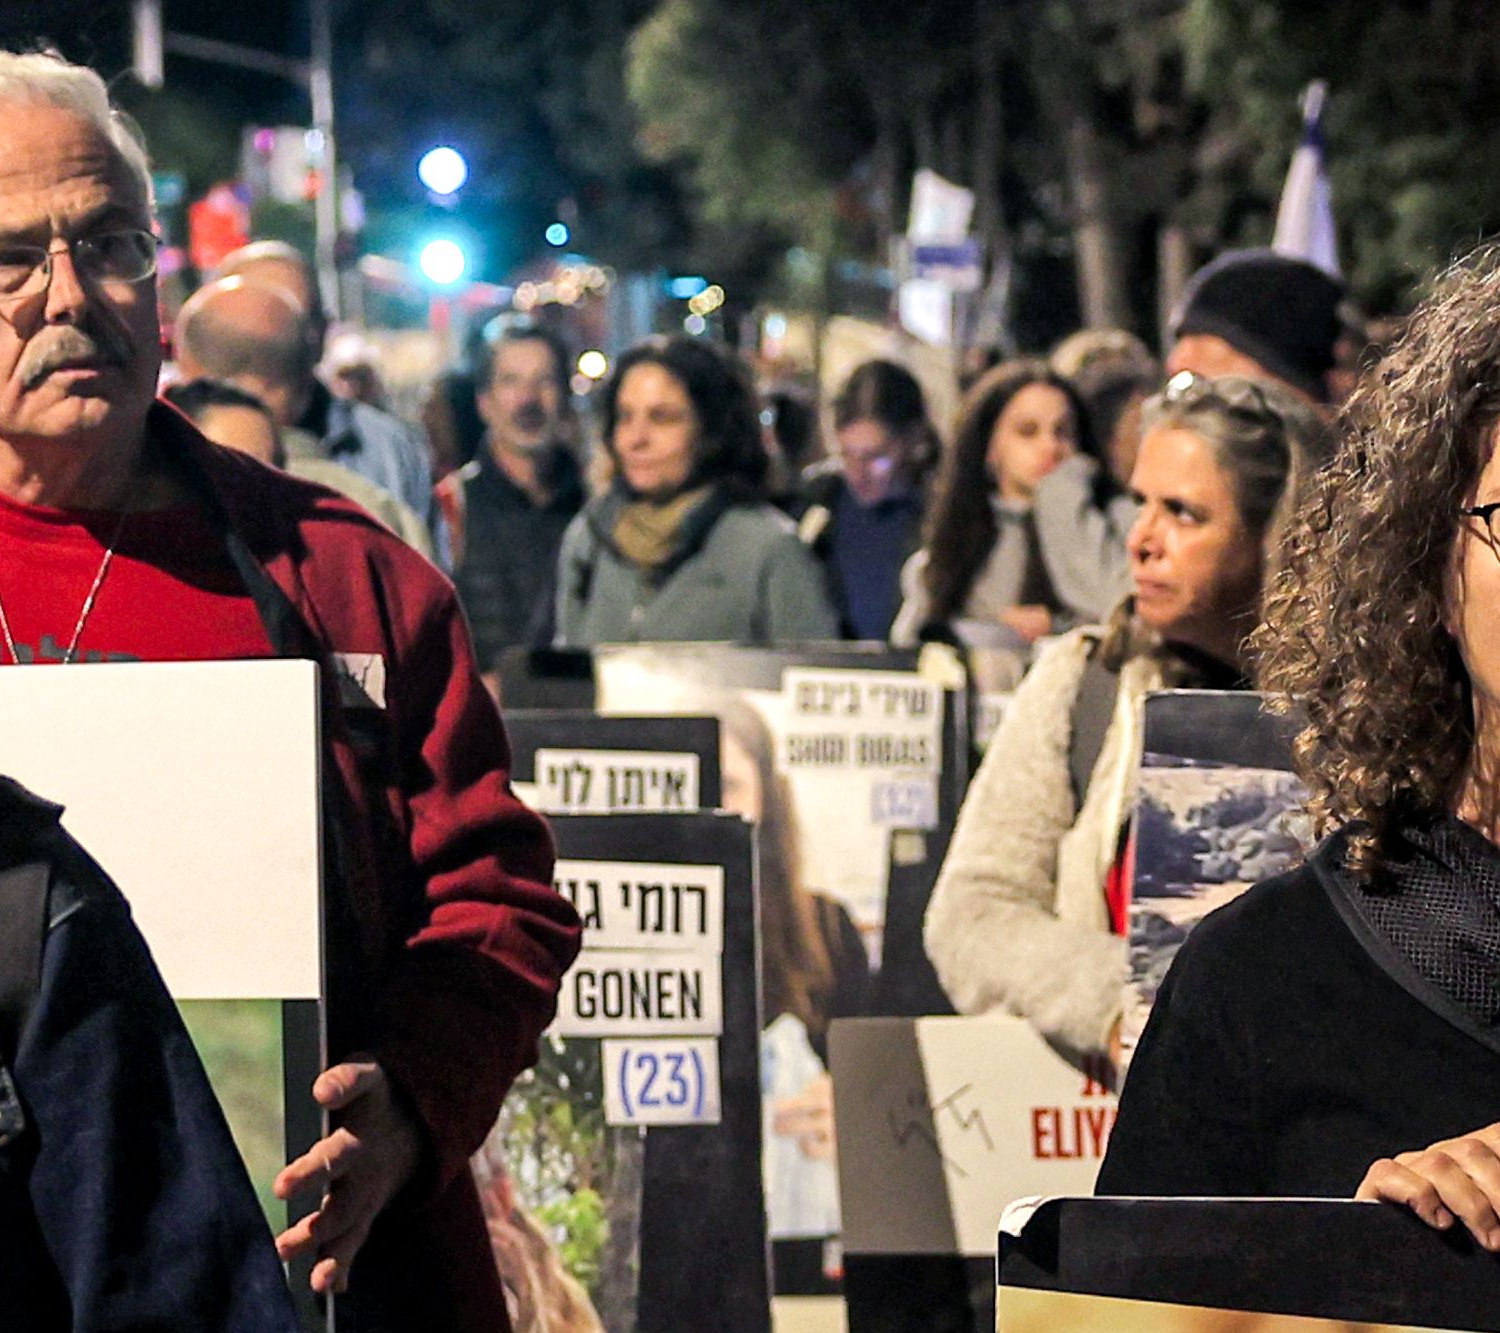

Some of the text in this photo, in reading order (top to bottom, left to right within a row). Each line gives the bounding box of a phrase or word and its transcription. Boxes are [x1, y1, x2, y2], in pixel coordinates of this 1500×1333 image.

[546, 759, 685, 810] איתן לוי
[621, 881, 707, 934] רומי
[575, 969, 702, 1020] GONEN
[619, 1048, 705, 1118] (23)
